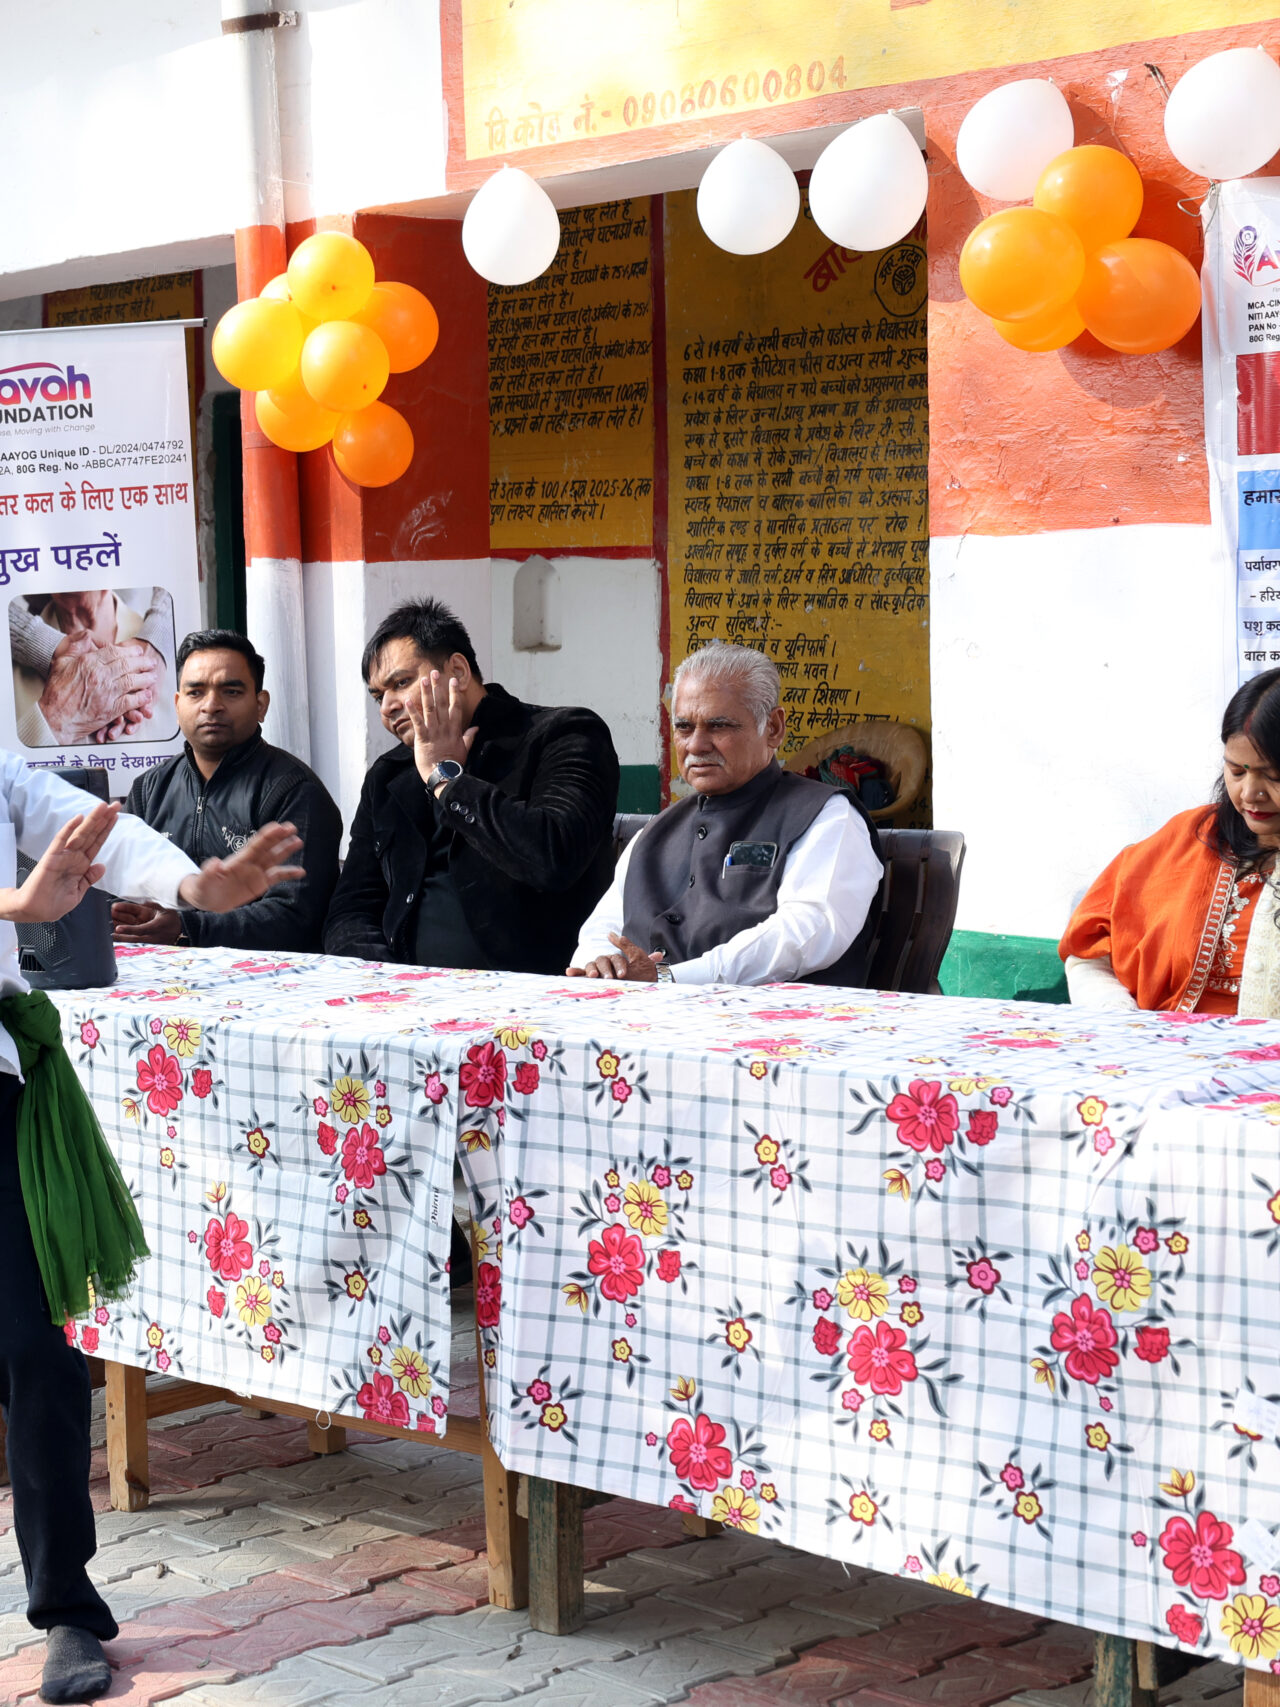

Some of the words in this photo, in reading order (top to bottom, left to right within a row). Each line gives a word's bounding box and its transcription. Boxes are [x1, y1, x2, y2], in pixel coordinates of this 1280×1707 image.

[1248, 301, 1266, 310] MCA
[1248, 312, 1263, 321] NITI
[1249, 323, 1265, 332] PAN
[1267, 322, 1277, 330] No
[1249, 334, 1264, 343] 80G
[14, 426, 43, 438] Moving
[46, 424, 61, 435] with
[63, 422, 96, 434] Change
[0, 449, 37, 462] AAYOG
[40, 447, 76, 460] Unique
[79, 446, 90, 456] ID
[16, 463, 37, 475] 80G
[39, 461, 62, 474] Reg.
[65, 460, 79, 471] No
[24, 492, 55, 514] कल
[60, 481, 77, 512] के
[81, 480, 115, 511] लिए
[120, 485, 149, 510] एक
[153, 481, 189, 505] साथ
[767, 513, 808, 535] मानसिक
[857, 516, 879, 535] पर
[885, 511, 909, 533] रोक
[51, 531, 122, 571] पहलें
[684, 587, 723, 609] विद्यालय
[686, 616, 720, 632] अन्य
[1243, 620, 1263, 636] पशु
[1244, 650, 1267, 662] बाल
[806, 663, 829, 681] भवन
[783, 688, 807, 706] द्वारा
[813, 681, 852, 706] शिक्षण
[87, 754, 117, 770] लिए
